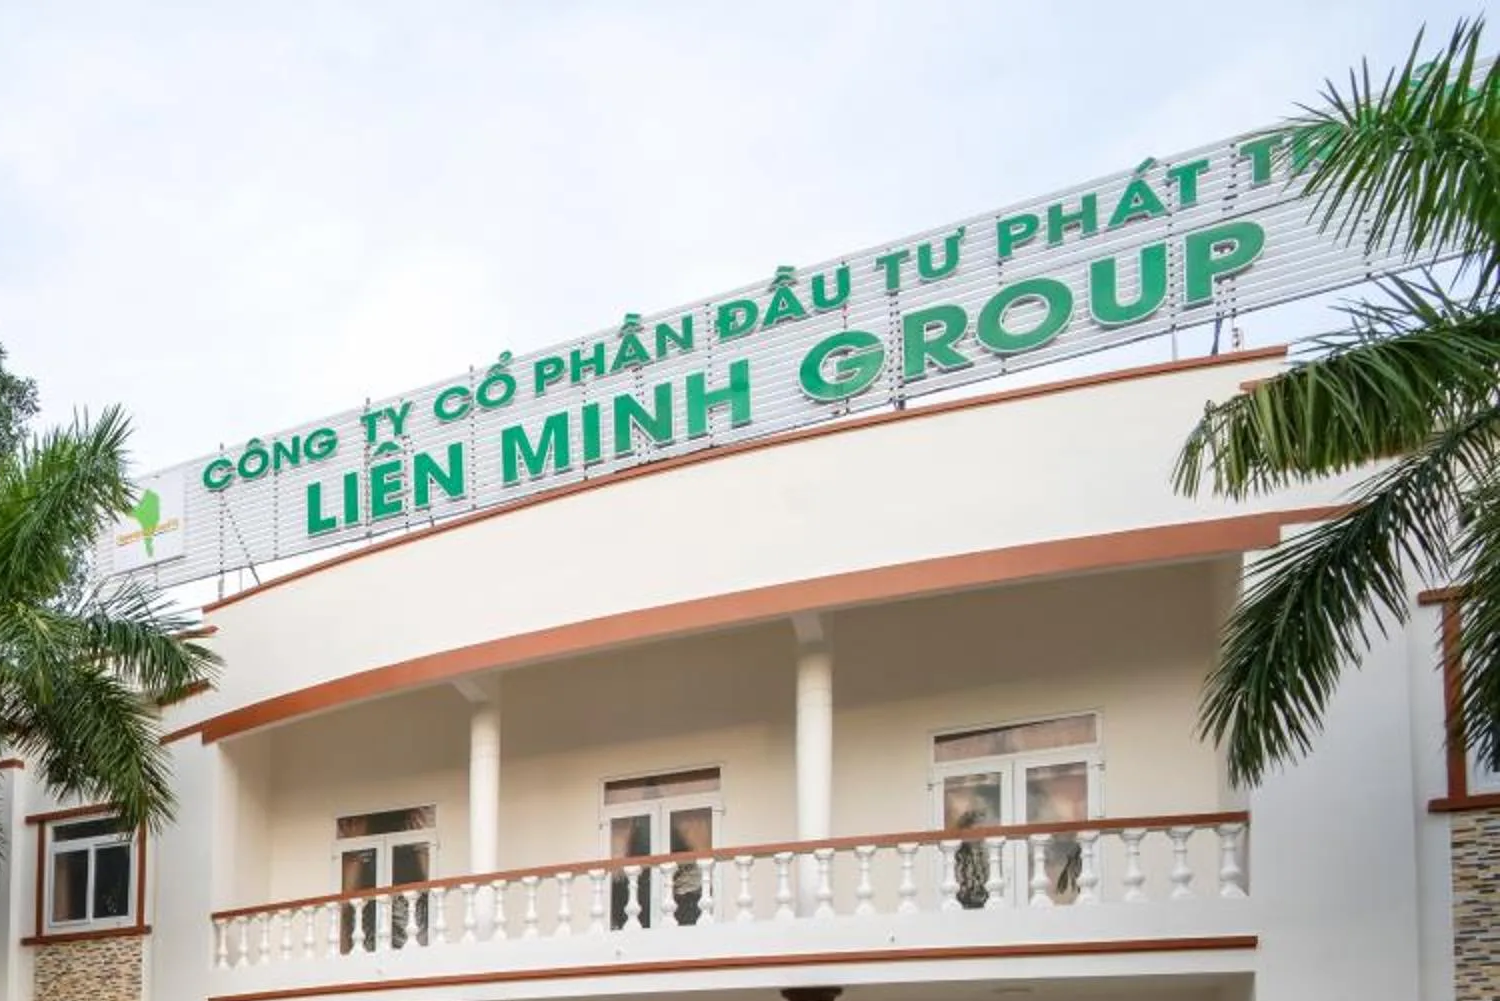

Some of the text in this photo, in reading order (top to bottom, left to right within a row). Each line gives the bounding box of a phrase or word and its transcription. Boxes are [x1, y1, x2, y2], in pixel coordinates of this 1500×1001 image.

[202, 426, 338, 491] CÔNG
[359, 402, 411, 444] TY
[433, 349, 517, 422] CỔ
[875, 227, 966, 291] TƯ
[996, 157, 1210, 258] PHÁT
[306, 221, 1266, 536] LIÊN MINH GROUP
